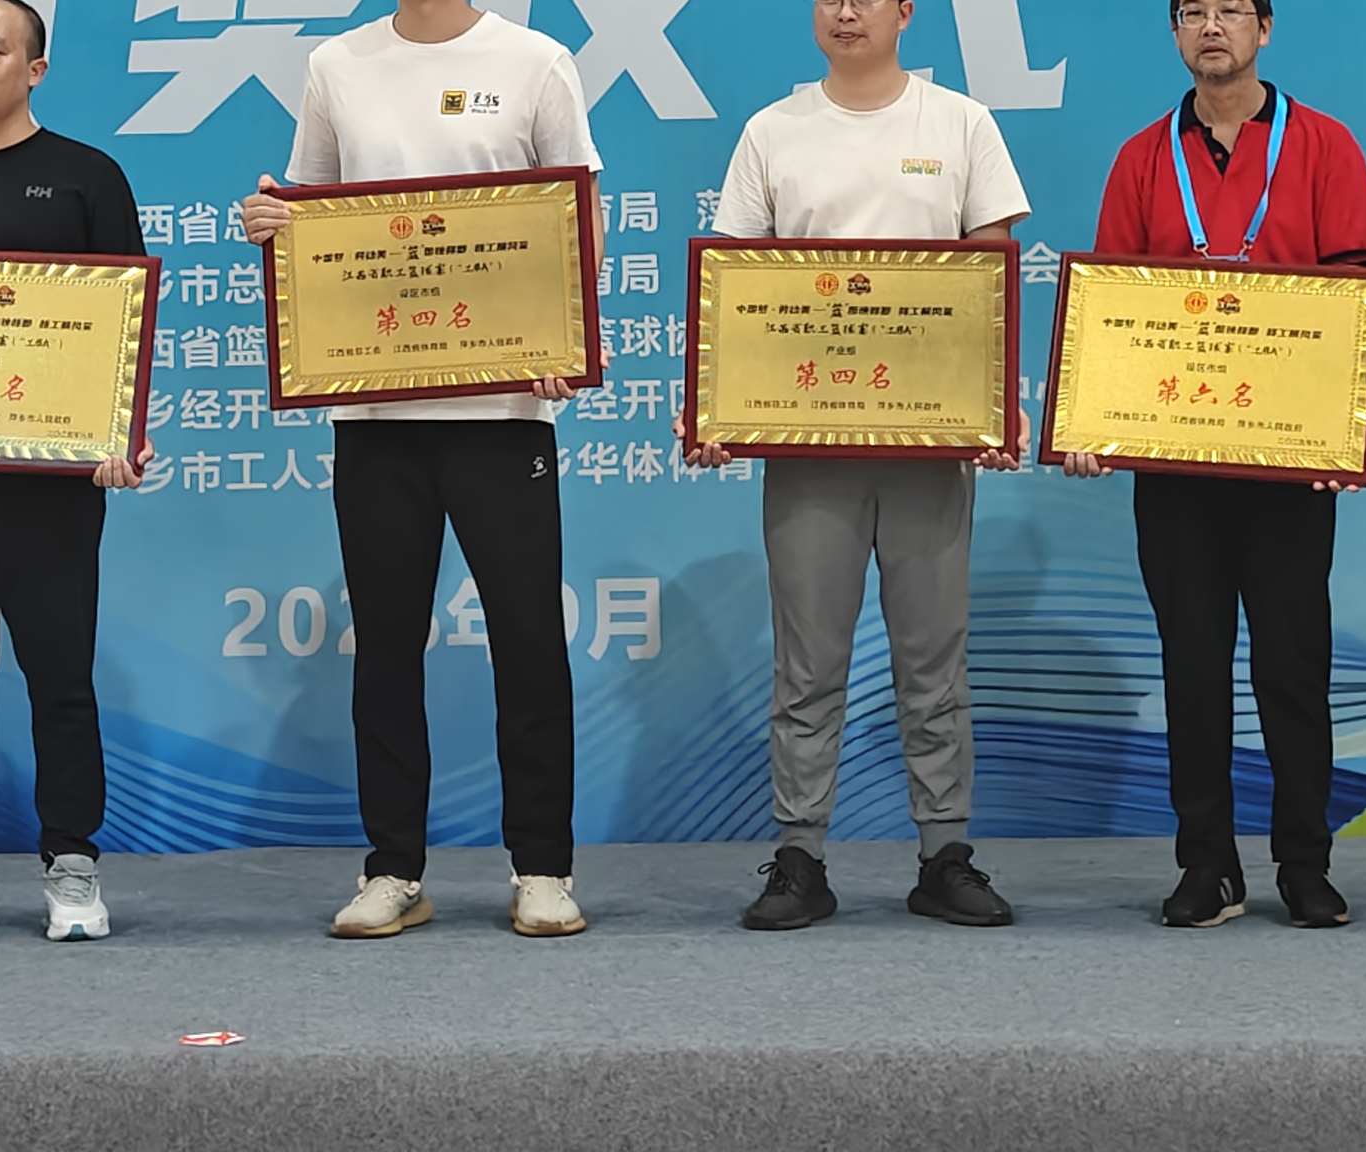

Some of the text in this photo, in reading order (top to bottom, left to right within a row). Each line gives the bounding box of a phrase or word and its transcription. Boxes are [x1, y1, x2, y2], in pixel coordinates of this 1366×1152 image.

[377, 301, 471, 337] 第四名
[796, 360, 890, 391] 第四名
[1156, 375, 1254, 408] 第六名
